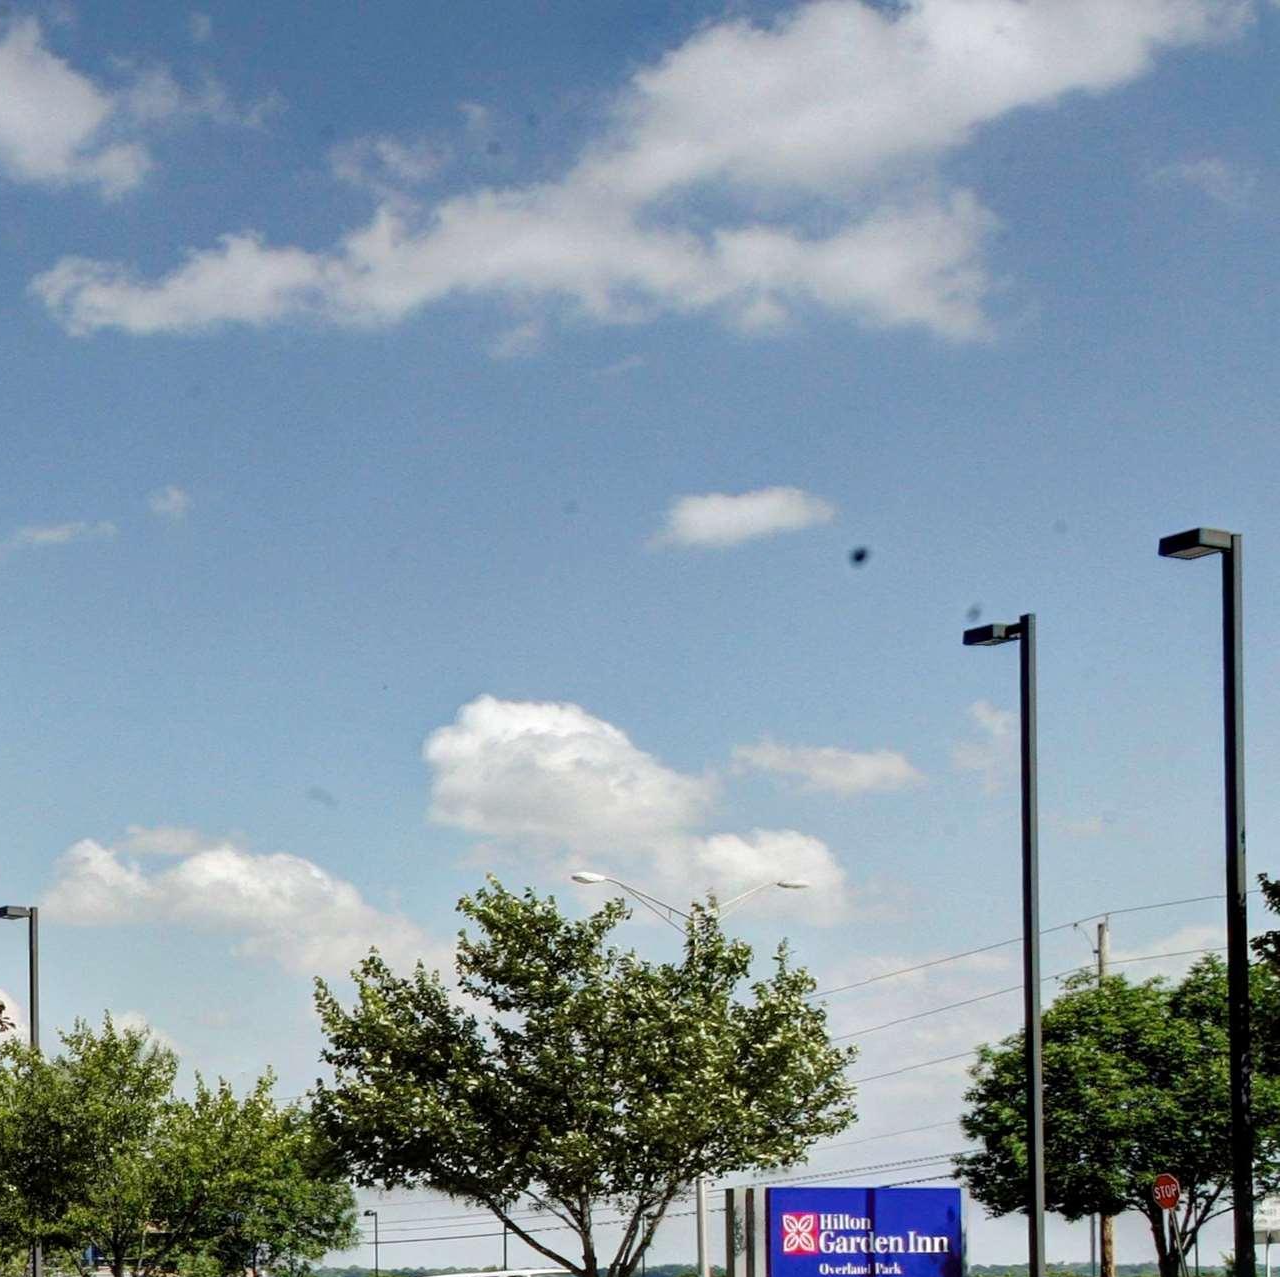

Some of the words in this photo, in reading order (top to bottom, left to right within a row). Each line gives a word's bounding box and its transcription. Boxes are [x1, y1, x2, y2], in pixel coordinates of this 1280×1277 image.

[1154, 1184, 1177, 1200] STOP
[820, 1213, 871, 1230] Hilton
[819, 1230, 905, 1254] Garden
[907, 1230, 949, 1253] Inn
[819, 1262, 871, 1275] Overland
[875, 1262, 902, 1275] Park
